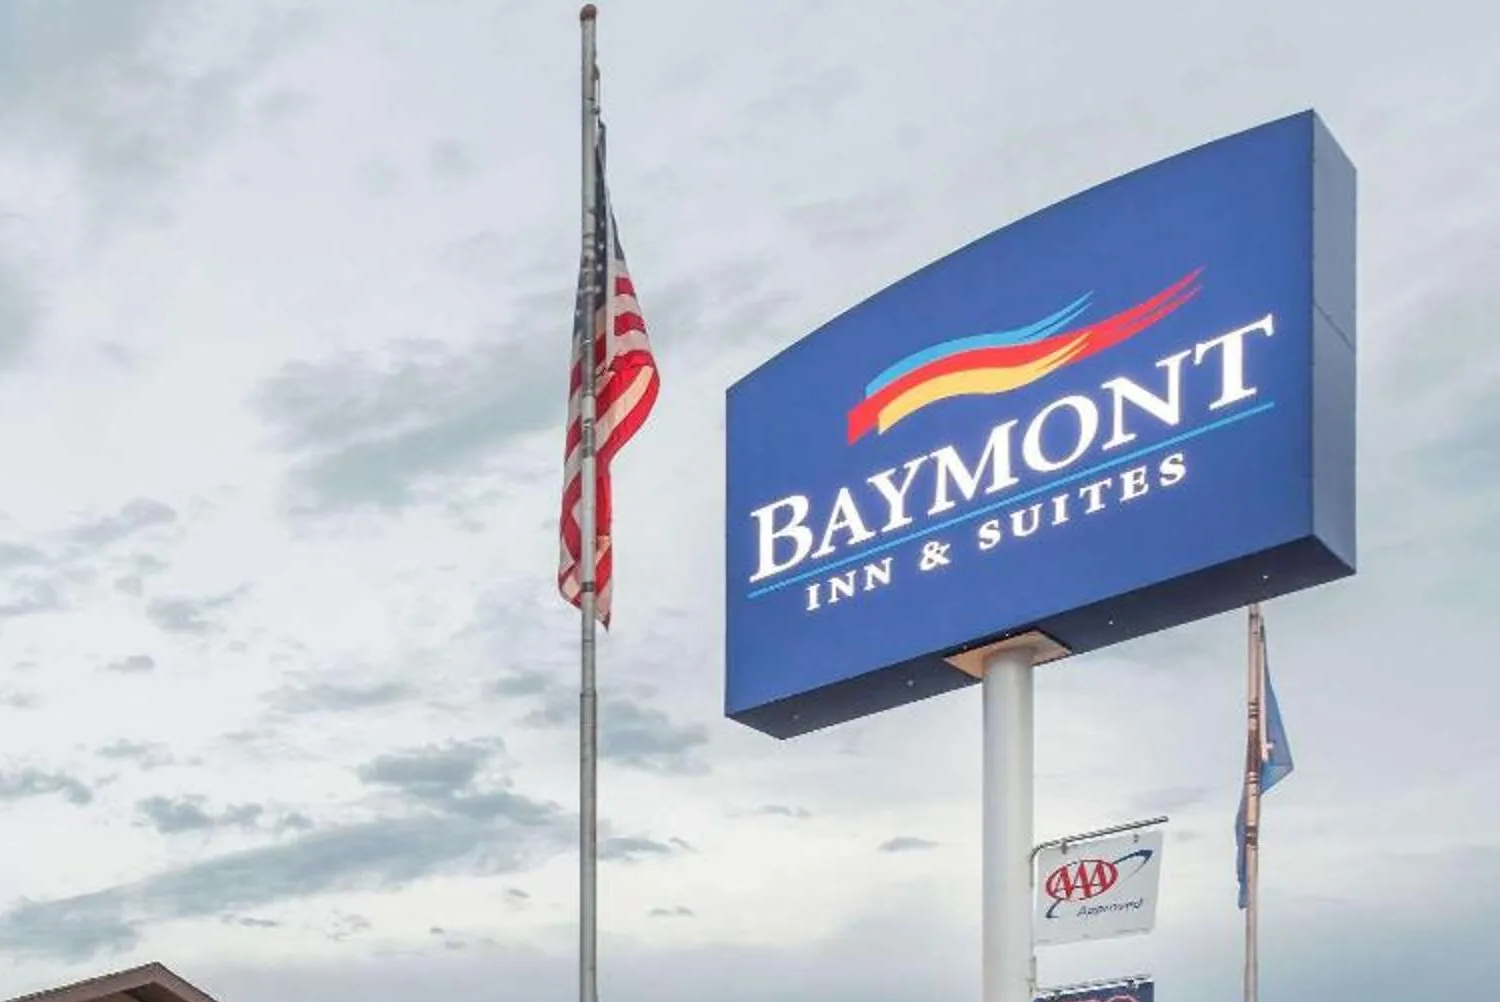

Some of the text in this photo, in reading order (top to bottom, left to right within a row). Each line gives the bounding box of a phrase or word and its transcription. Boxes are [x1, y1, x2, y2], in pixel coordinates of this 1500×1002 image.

[749, 314, 1275, 583] BAYMONT
[805, 451, 1188, 611] INN & SUITES
[1050, 860, 1114, 899] AAA
